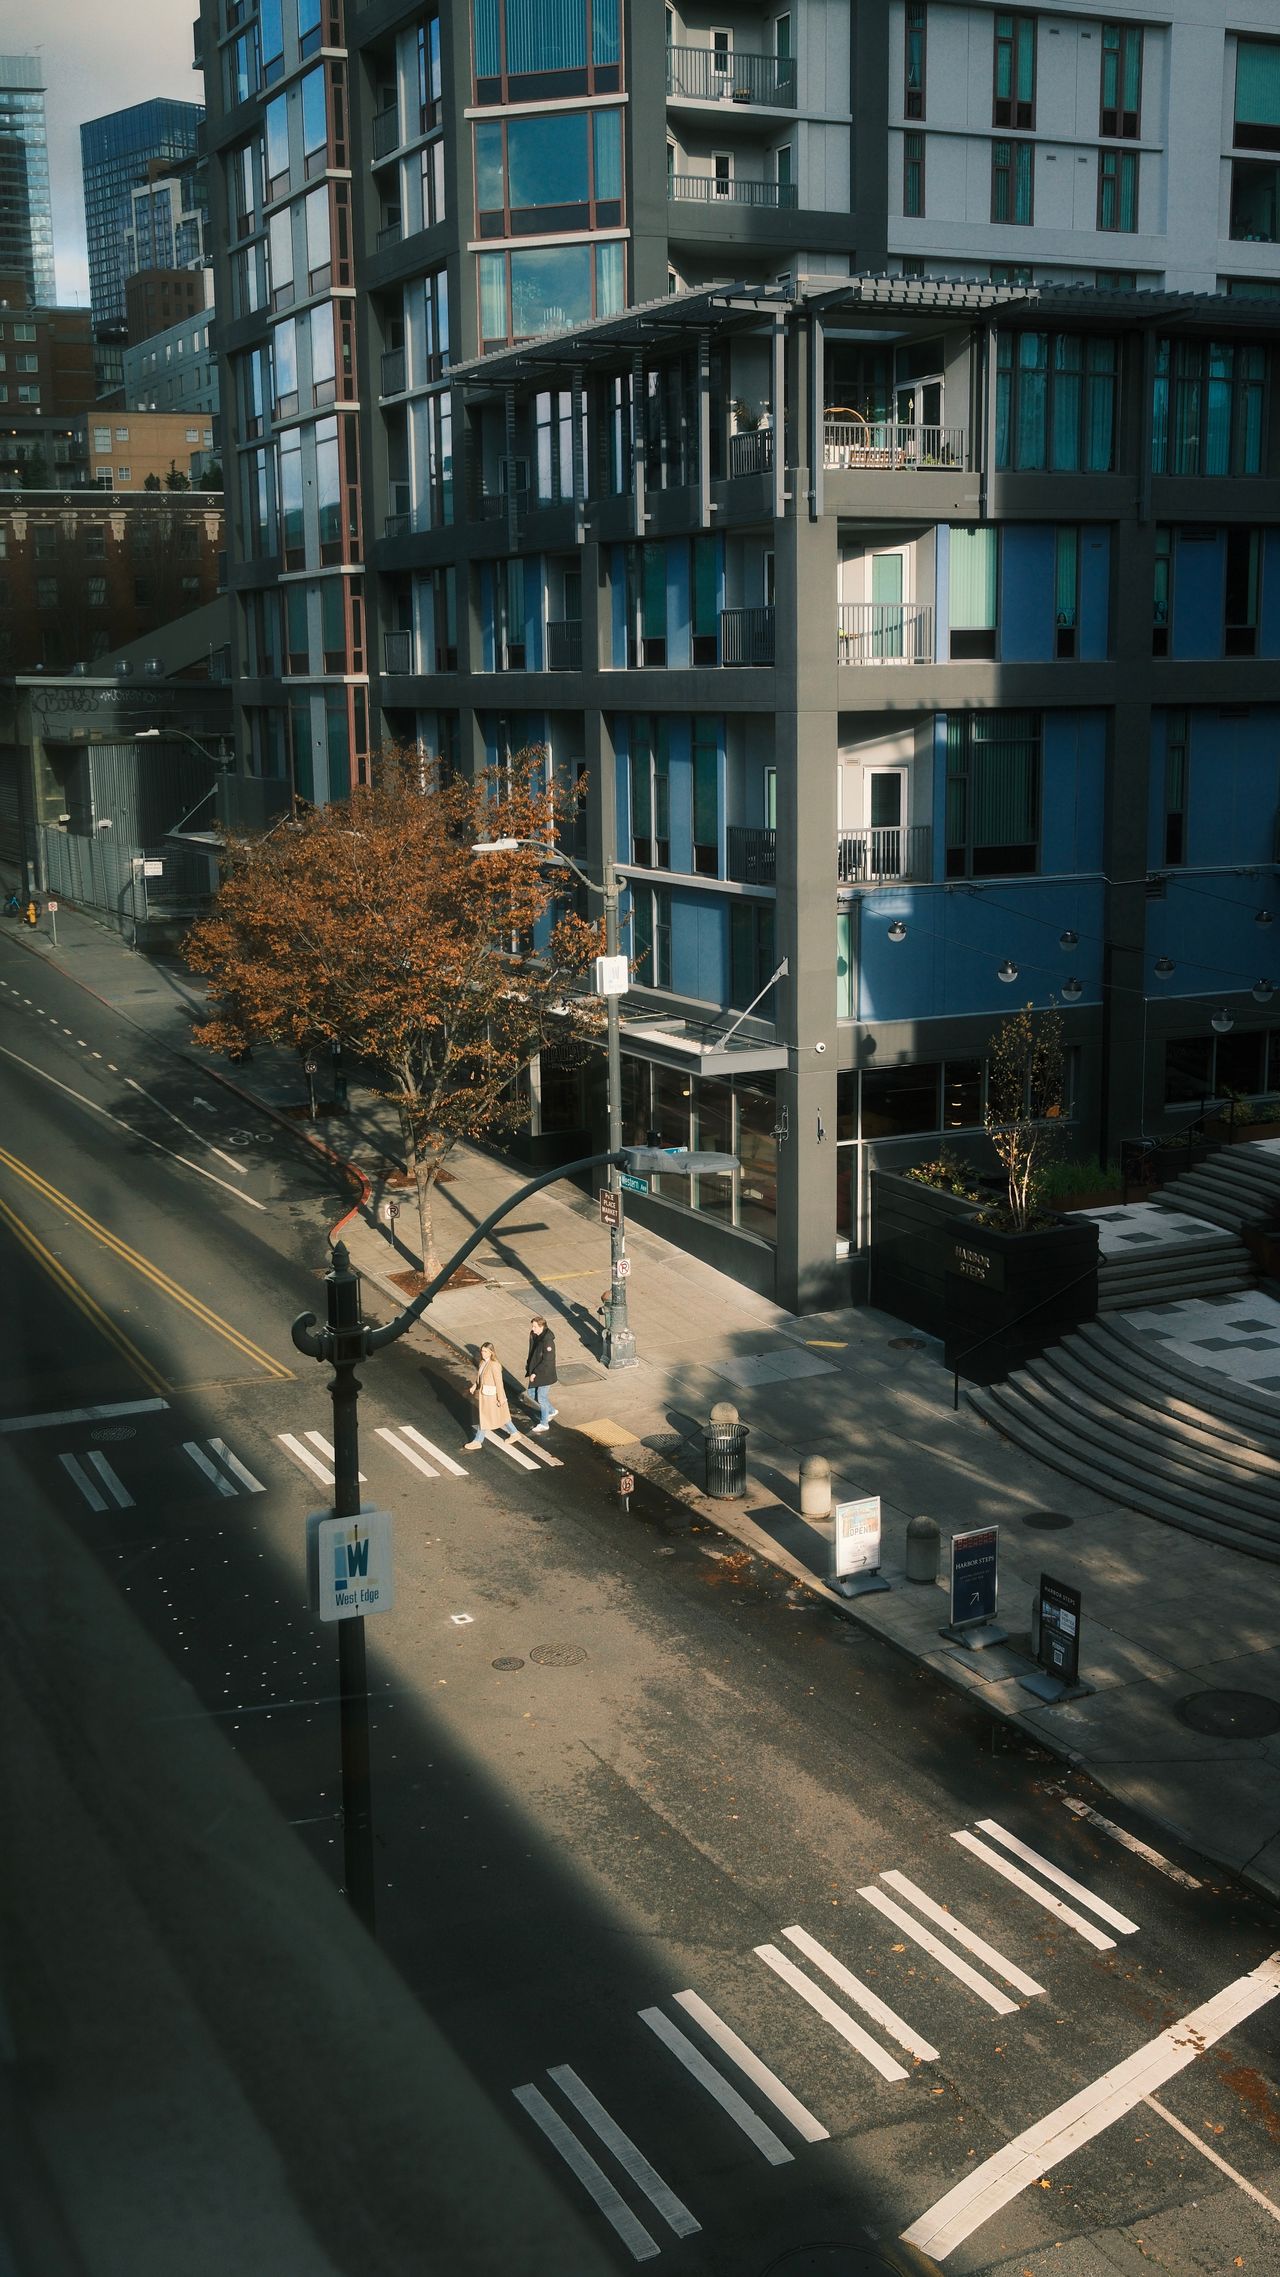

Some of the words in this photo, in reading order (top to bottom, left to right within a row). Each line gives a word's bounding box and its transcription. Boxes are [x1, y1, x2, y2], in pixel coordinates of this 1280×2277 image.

[622, 1175, 640, 1190] Western
[602, 1206, 618, 1216] MARKET
[603, 1199, 616, 1209] PLACE
[954, 1245, 991, 1269] HARBOR
[960, 1262, 986, 1280] STEPS
[347, 1538, 369, 1578] W
[955, 1559, 978, 1570] HARBOR
[978, 1556, 994, 1565] STEPS
[335, 1590, 357, 1606] West
[360, 1588, 379, 1604] Edge
[1044, 1586, 1062, 1598] HARBOR
[1062, 1594, 1076, 1606] STEPS
